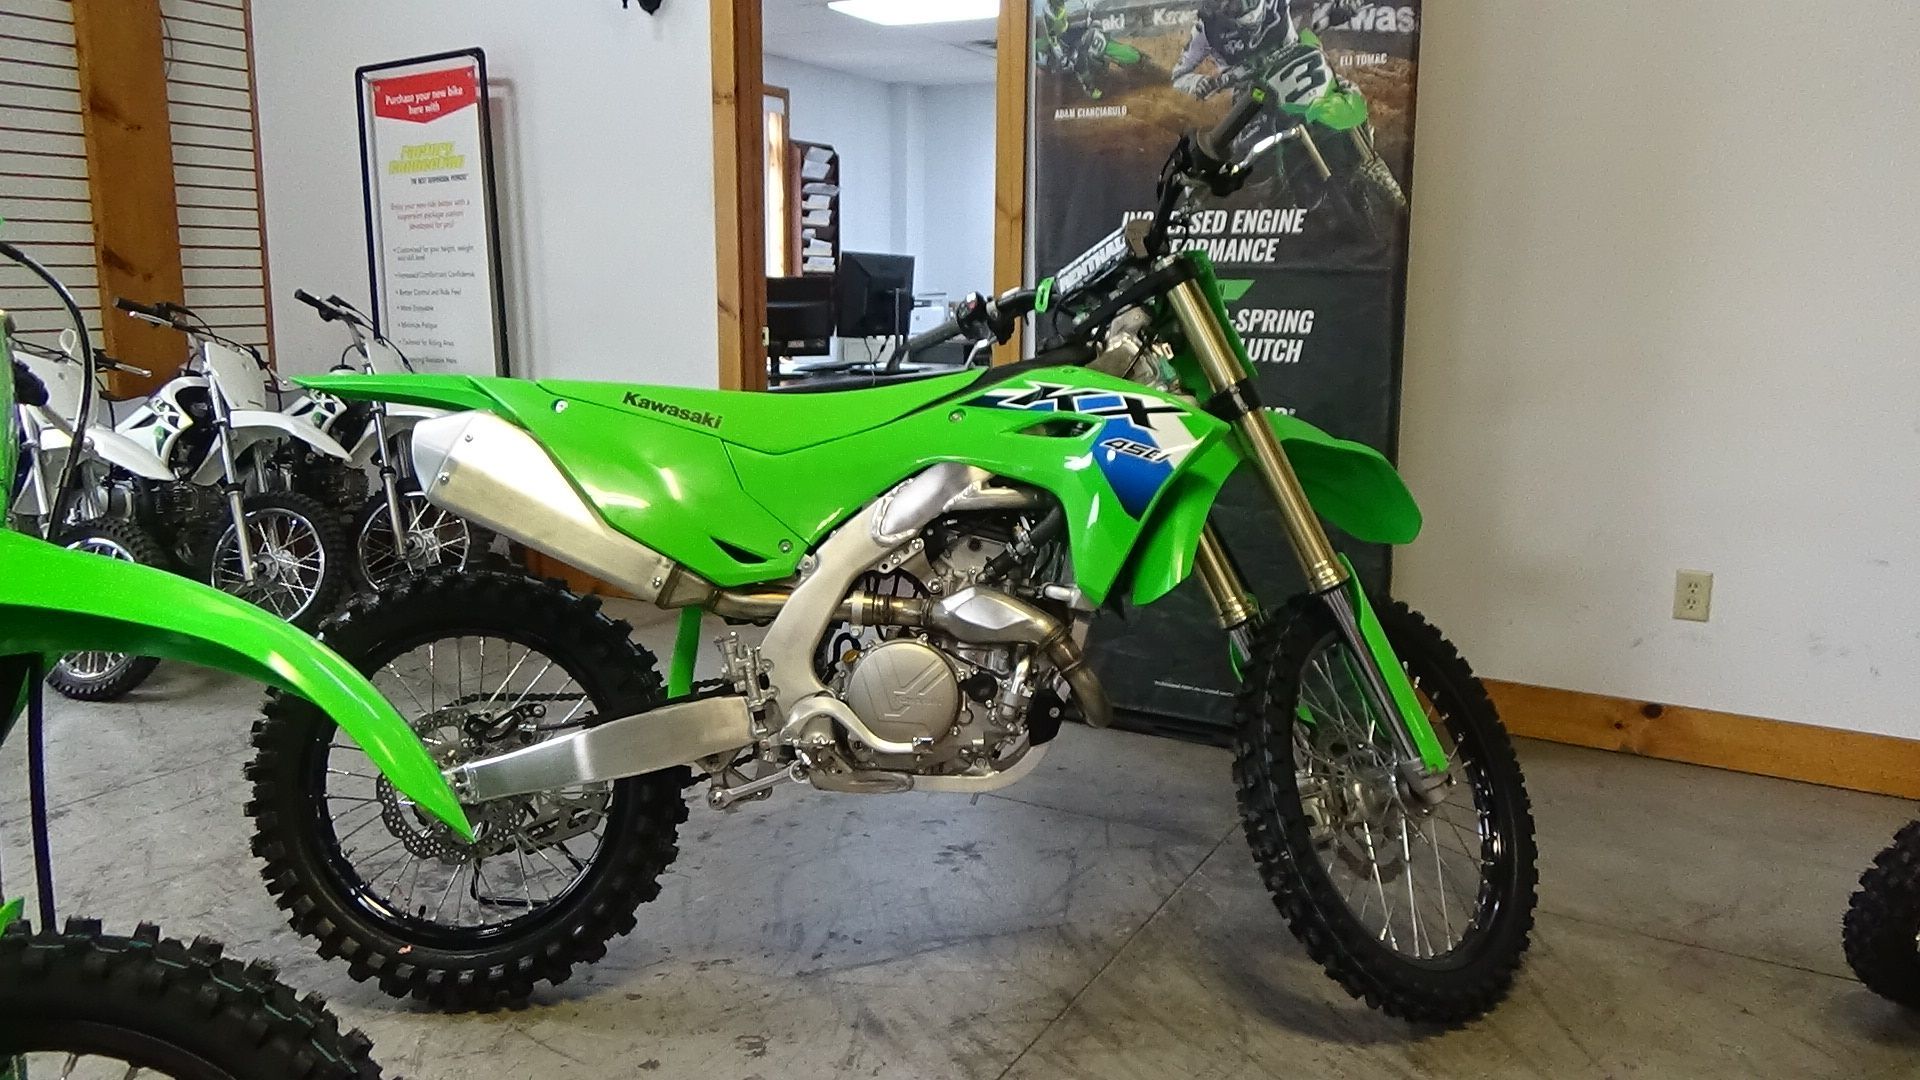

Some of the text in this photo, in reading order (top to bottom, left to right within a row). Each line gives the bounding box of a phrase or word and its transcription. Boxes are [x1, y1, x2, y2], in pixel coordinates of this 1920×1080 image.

[1340, 53, 1388, 66] ELI TOMAC
[1279, 51, 1327, 104] 3
[385, 85, 463, 106] Purchase your new bike
[408, 101, 440, 115] here with
[1054, 107, 1076, 120] ADAM
[1231, 208, 1308, 234] ENGINE
[623, 391, 723, 429] Kawasaki
[1102, 438, 1173, 462] 450
